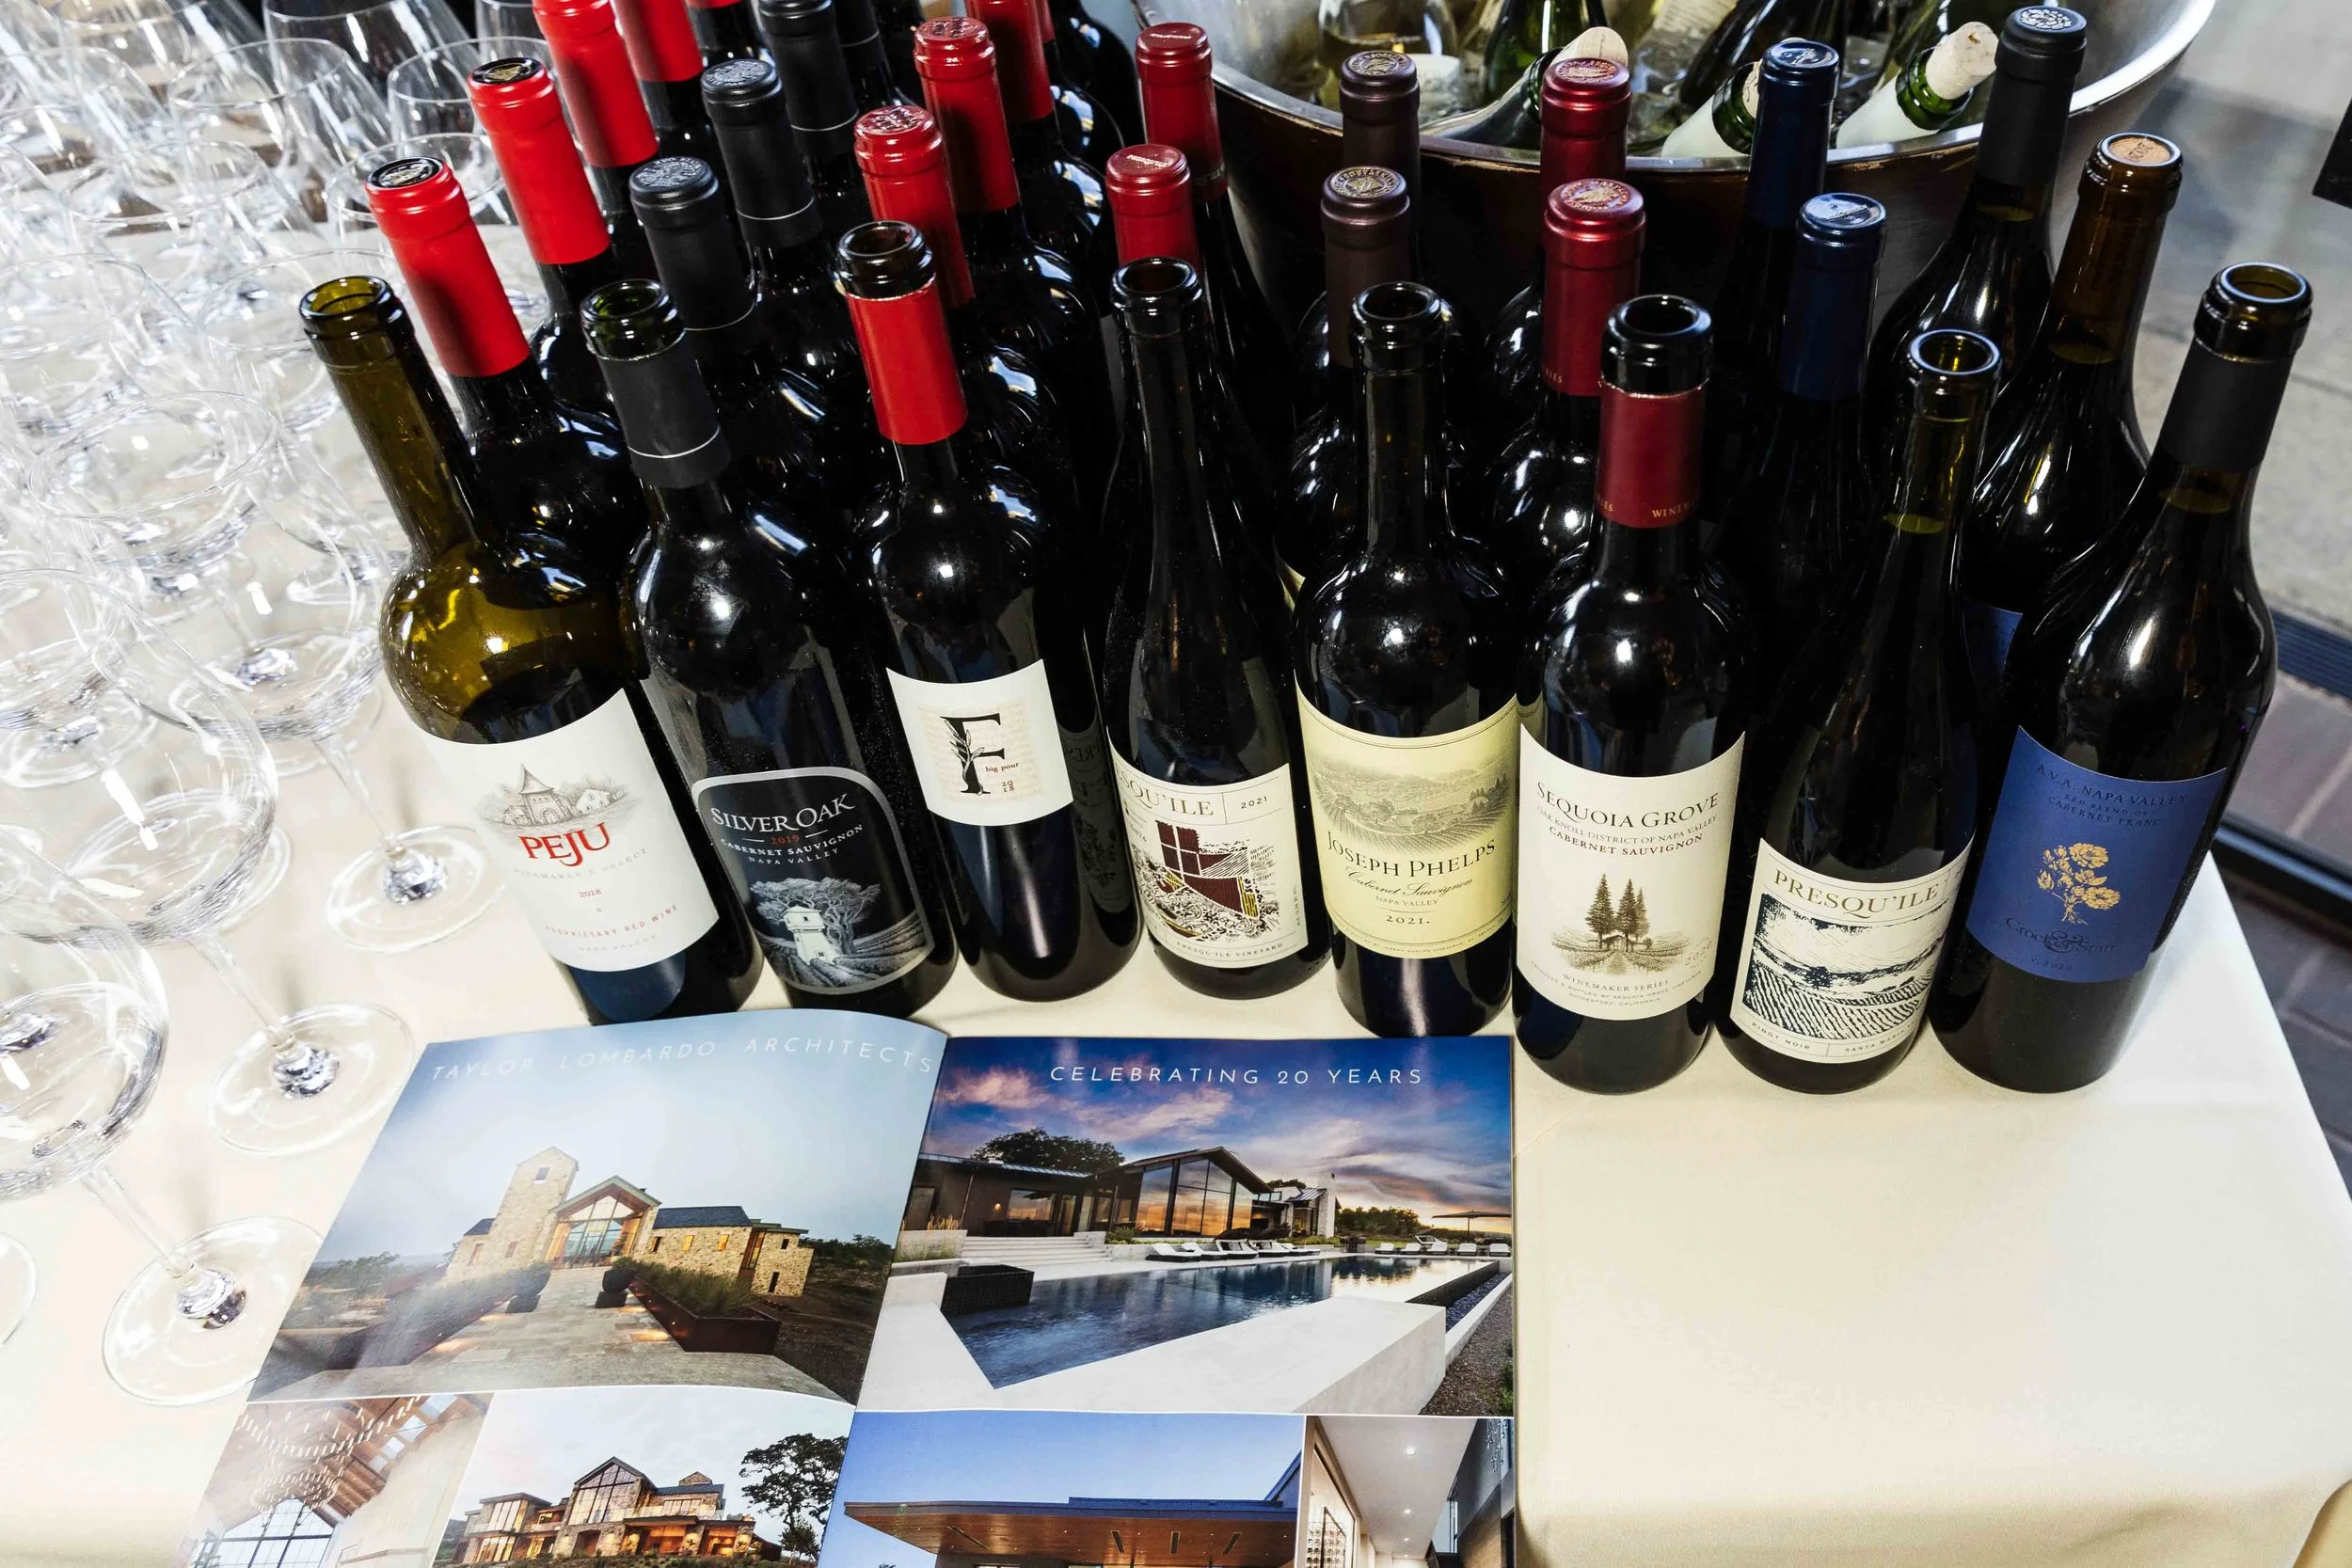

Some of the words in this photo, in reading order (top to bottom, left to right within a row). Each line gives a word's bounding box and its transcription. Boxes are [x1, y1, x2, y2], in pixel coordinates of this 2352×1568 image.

[940, 713, 1006, 796] F
[1001, 762, 1020, 771] pour
[1241, 796, 1268, 810] 2021
[1536, 781, 1634, 829] SEQUOIA
[1641, 792, 1719, 828] GROVE
[2082, 785, 2123, 804] NAPA
[2130, 794, 2189, 806] VALLEY
[711, 807, 799, 832] SILVER
[796, 793, 855, 828] OAK
[1536, 805, 1553, 822] OAK
[1554, 817, 1584, 837] KNOLL
[1587, 831, 1639, 845] DISTRICT
[1641, 836, 1656, 845] OF
[1658, 831, 1685, 844] NAPA
[1687, 814, 1718, 834] VALLEY
[2048, 796, 2112, 823] CABERNET
[2119, 817, 2161, 827] FRANC
[517, 822, 612, 867] PEJU
[721, 838, 783, 856] CABERNET
[787, 824, 864, 856] SAUVIGNON
[771, 834, 800, 845] 2019
[1549, 826, 1617, 855] CABERNET
[1622, 833, 1704, 856] SAUVIGNON
[748, 856, 781, 865] NAPA
[787, 847, 838, 863] VALLEY
[1327, 831, 1400, 877] JOSEPH
[1410, 838, 1496, 878] PHELPS
[579, 888, 602, 898] 2018
[1346, 865, 1398, 895] Cabernet
[1402, 879, 1473, 897] Sauvignon
[1774, 869, 1939, 919] PRESQU'ILE
[1375, 895, 1400, 906] NAPA
[1402, 897, 1440, 907] VALLEY
[624, 921, 645, 932] RED
[651, 904, 678, 923] WINE
[1235, 942, 1283, 958] VINEYARD
[1563, 974, 1630, 992] WINEMAKER
[1634, 979, 1669, 992] SERIES
[431, 1057, 533, 1081] TAYLOR
[560, 1040, 716, 1070] LOMBARDO
[744, 1037, 932, 1074] ARCHITECTS
[1785, 1039, 1810, 1051] NOIR
[1050, 1067, 1259, 1085] CELEBRATING
[1278, 1070, 1310, 1085] 20
[1328, 1069, 1422, 1085] YEARS
